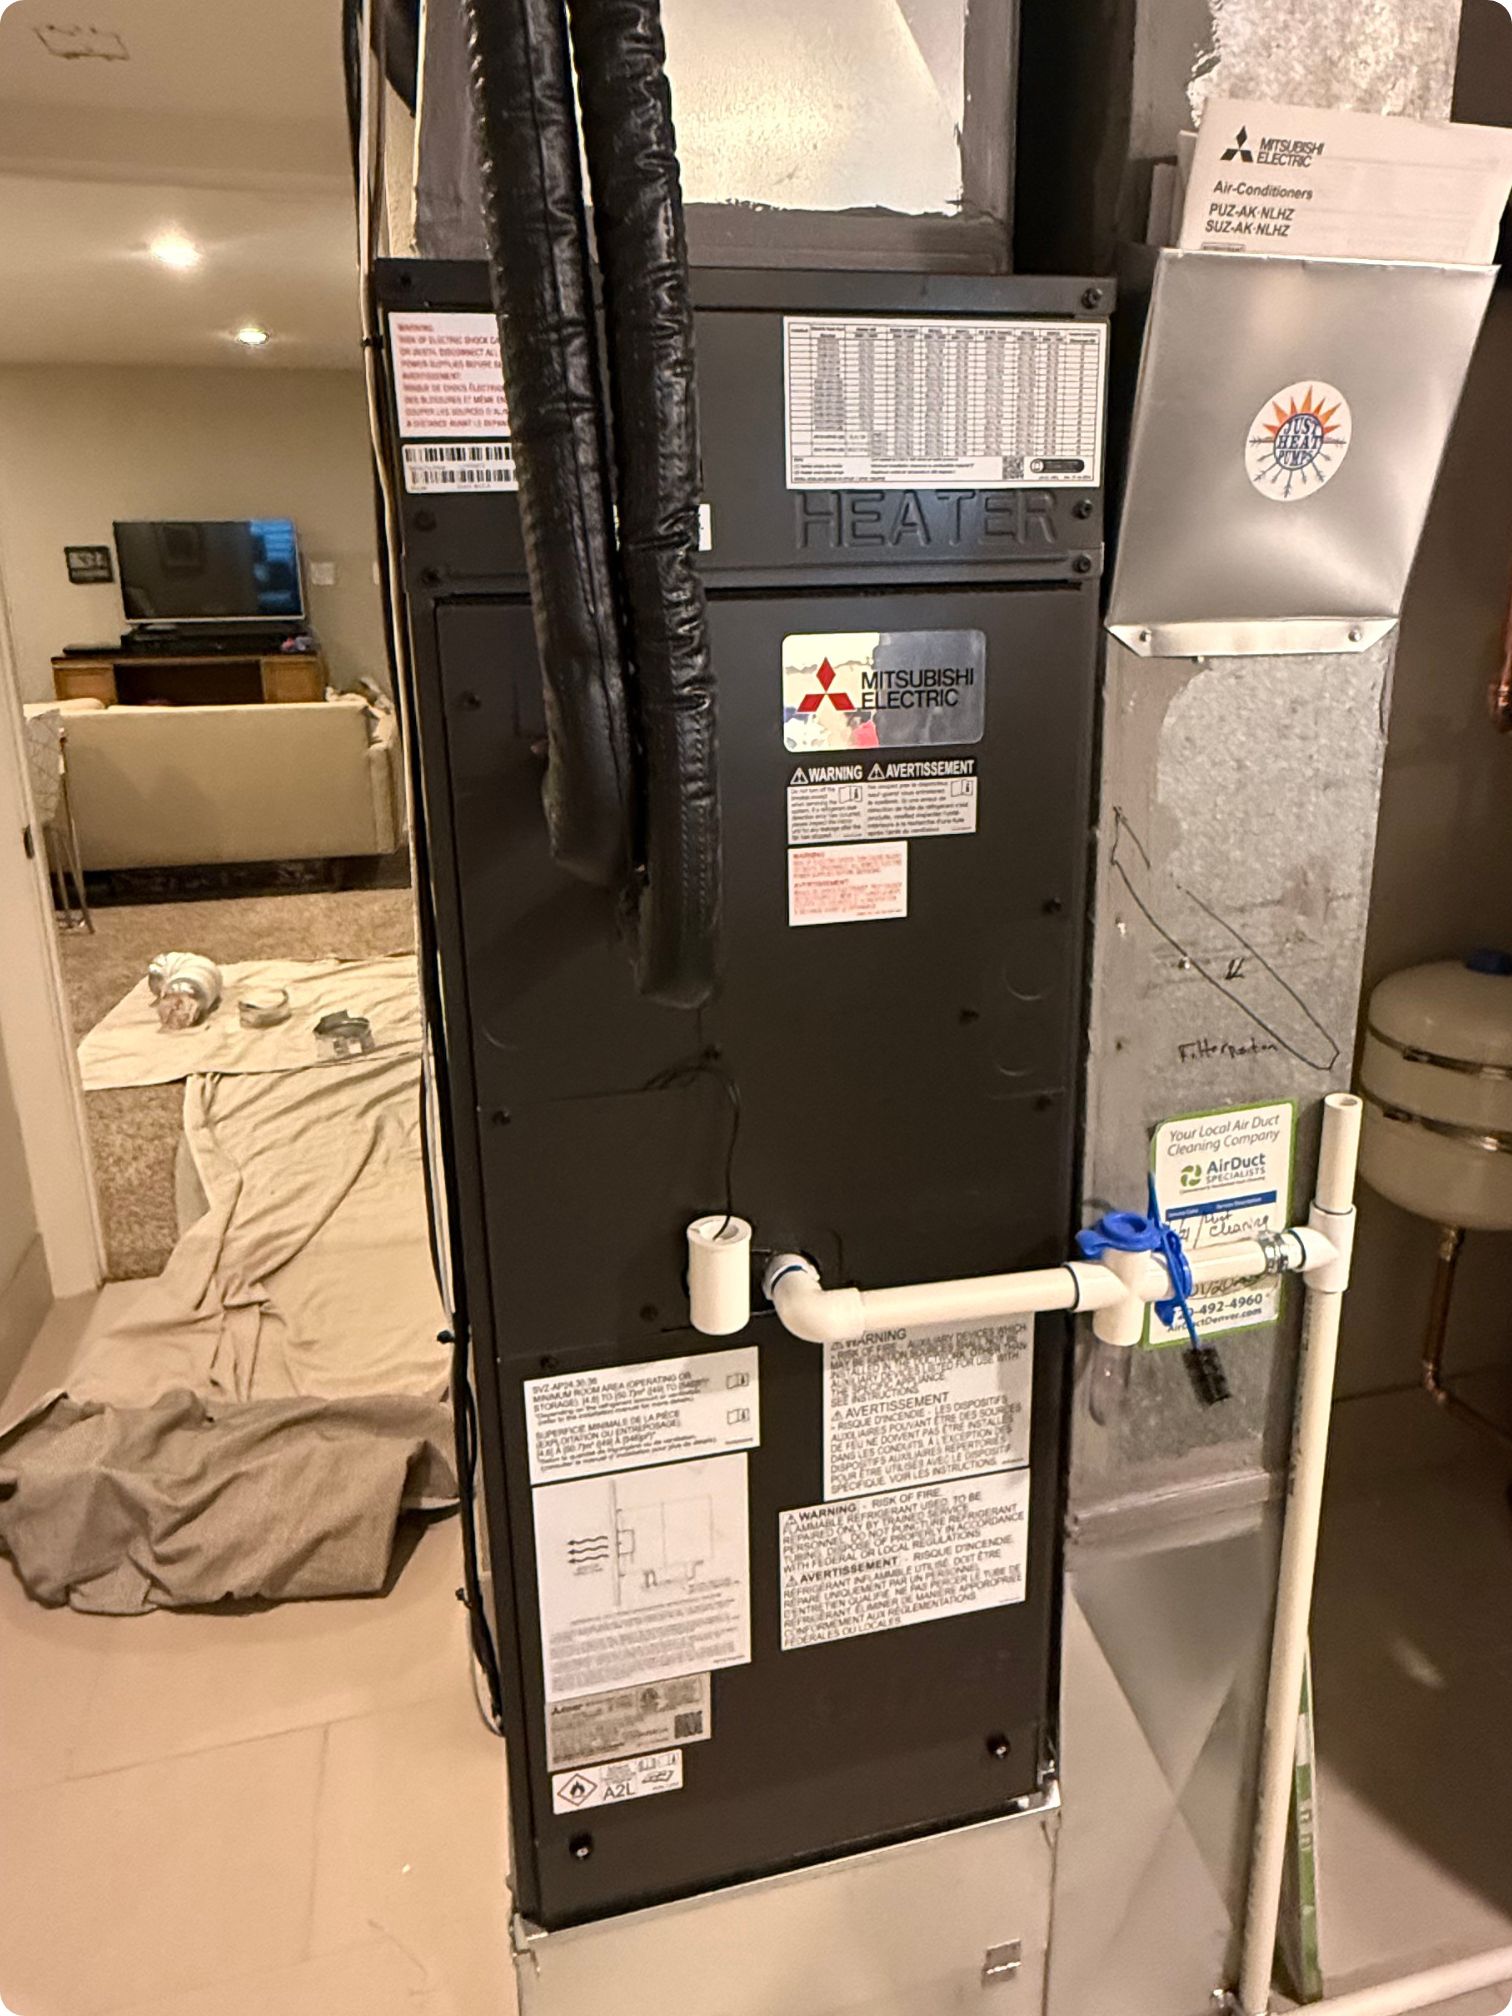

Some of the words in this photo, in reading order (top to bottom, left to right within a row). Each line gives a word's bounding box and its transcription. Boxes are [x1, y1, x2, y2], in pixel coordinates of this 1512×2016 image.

[1260, 138, 1325, 156] MITSUBISHI
[1257, 152, 1312, 168] ELECTRIC
[1213, 181, 1314, 200] Air-Conditioners
[1284, 416, 1323, 436] JUST
[1276, 435, 1324, 450] HEAT
[1278, 450, 1315, 467] PUMPS
[797, 489, 1057, 549] HEATER
[861, 668, 975, 691] MITSUBISHI
[861, 688, 959, 711] ELECTRIC
[808, 765, 864, 784] WARNING
[886, 760, 975, 779] AVERTISSEMENT
[1169, 1129, 1198, 1143] Your
[1199, 1121, 1231, 1138] Local
[1233, 1119, 1250, 1133] Air
[1252, 1115, 1280, 1130] Duct
[1167, 1139, 1221, 1157] Cleaning
[1224, 1129, 1280, 1148] Company
[1207, 1153, 1267, 1175] AirDuct
[1206, 1167, 1267, 1185] SPECIALISTS
[845, 1391, 949, 1418] AVERTISSEMENT
[798, 1501, 857, 1522] WARNING
[871, 1494, 896, 1508] RISK
[899, 1491, 913, 1503] OF
[877, 1541, 909, 1556] LOCAL
[799, 1555, 898, 1584] AVERTISSEMENT
[912, 1544, 952, 1562] RISQUE
[604, 1780, 635, 1801] A2L
